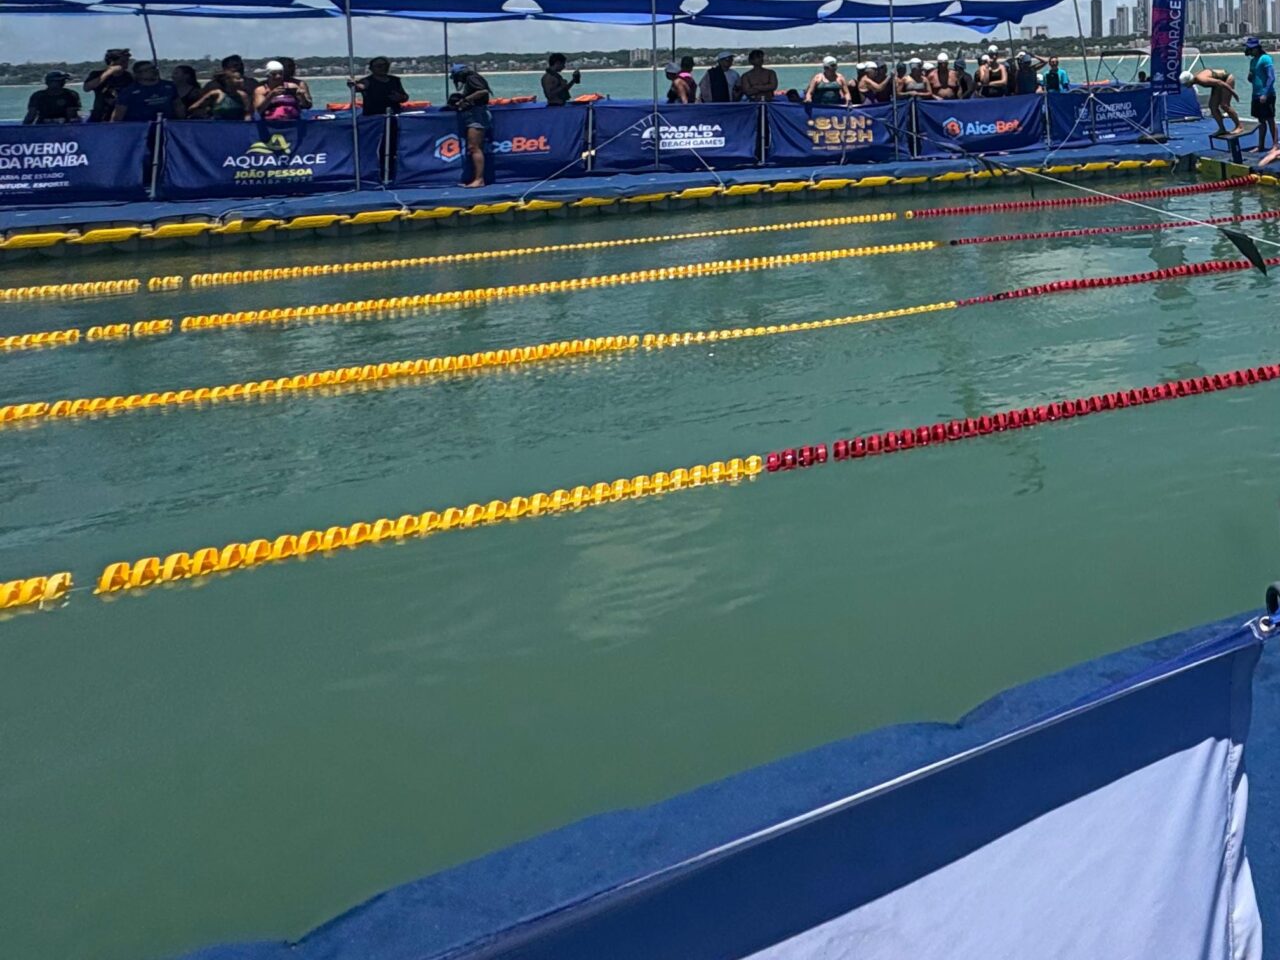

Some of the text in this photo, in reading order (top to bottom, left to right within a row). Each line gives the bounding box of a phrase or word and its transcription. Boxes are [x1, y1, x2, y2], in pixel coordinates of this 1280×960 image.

[1167, 0, 1182, 81] AQUARACE
[1096, 102, 1132, 113] GOVERNO
[659, 123, 722, 132] PARAÍBA
[815, 116, 866, 130] SUN
[660, 131, 713, 139] WORLD
[807, 129, 873, 144] TECH
[0, 141, 78, 156] GOVERNO
[661, 137, 724, 148] BEACH GAMES
[0, 151, 89, 169] DA PARAÍBA
[223, 152, 327, 169] AQUARACE
[234, 167, 313, 179] JOÃO PESSOA
